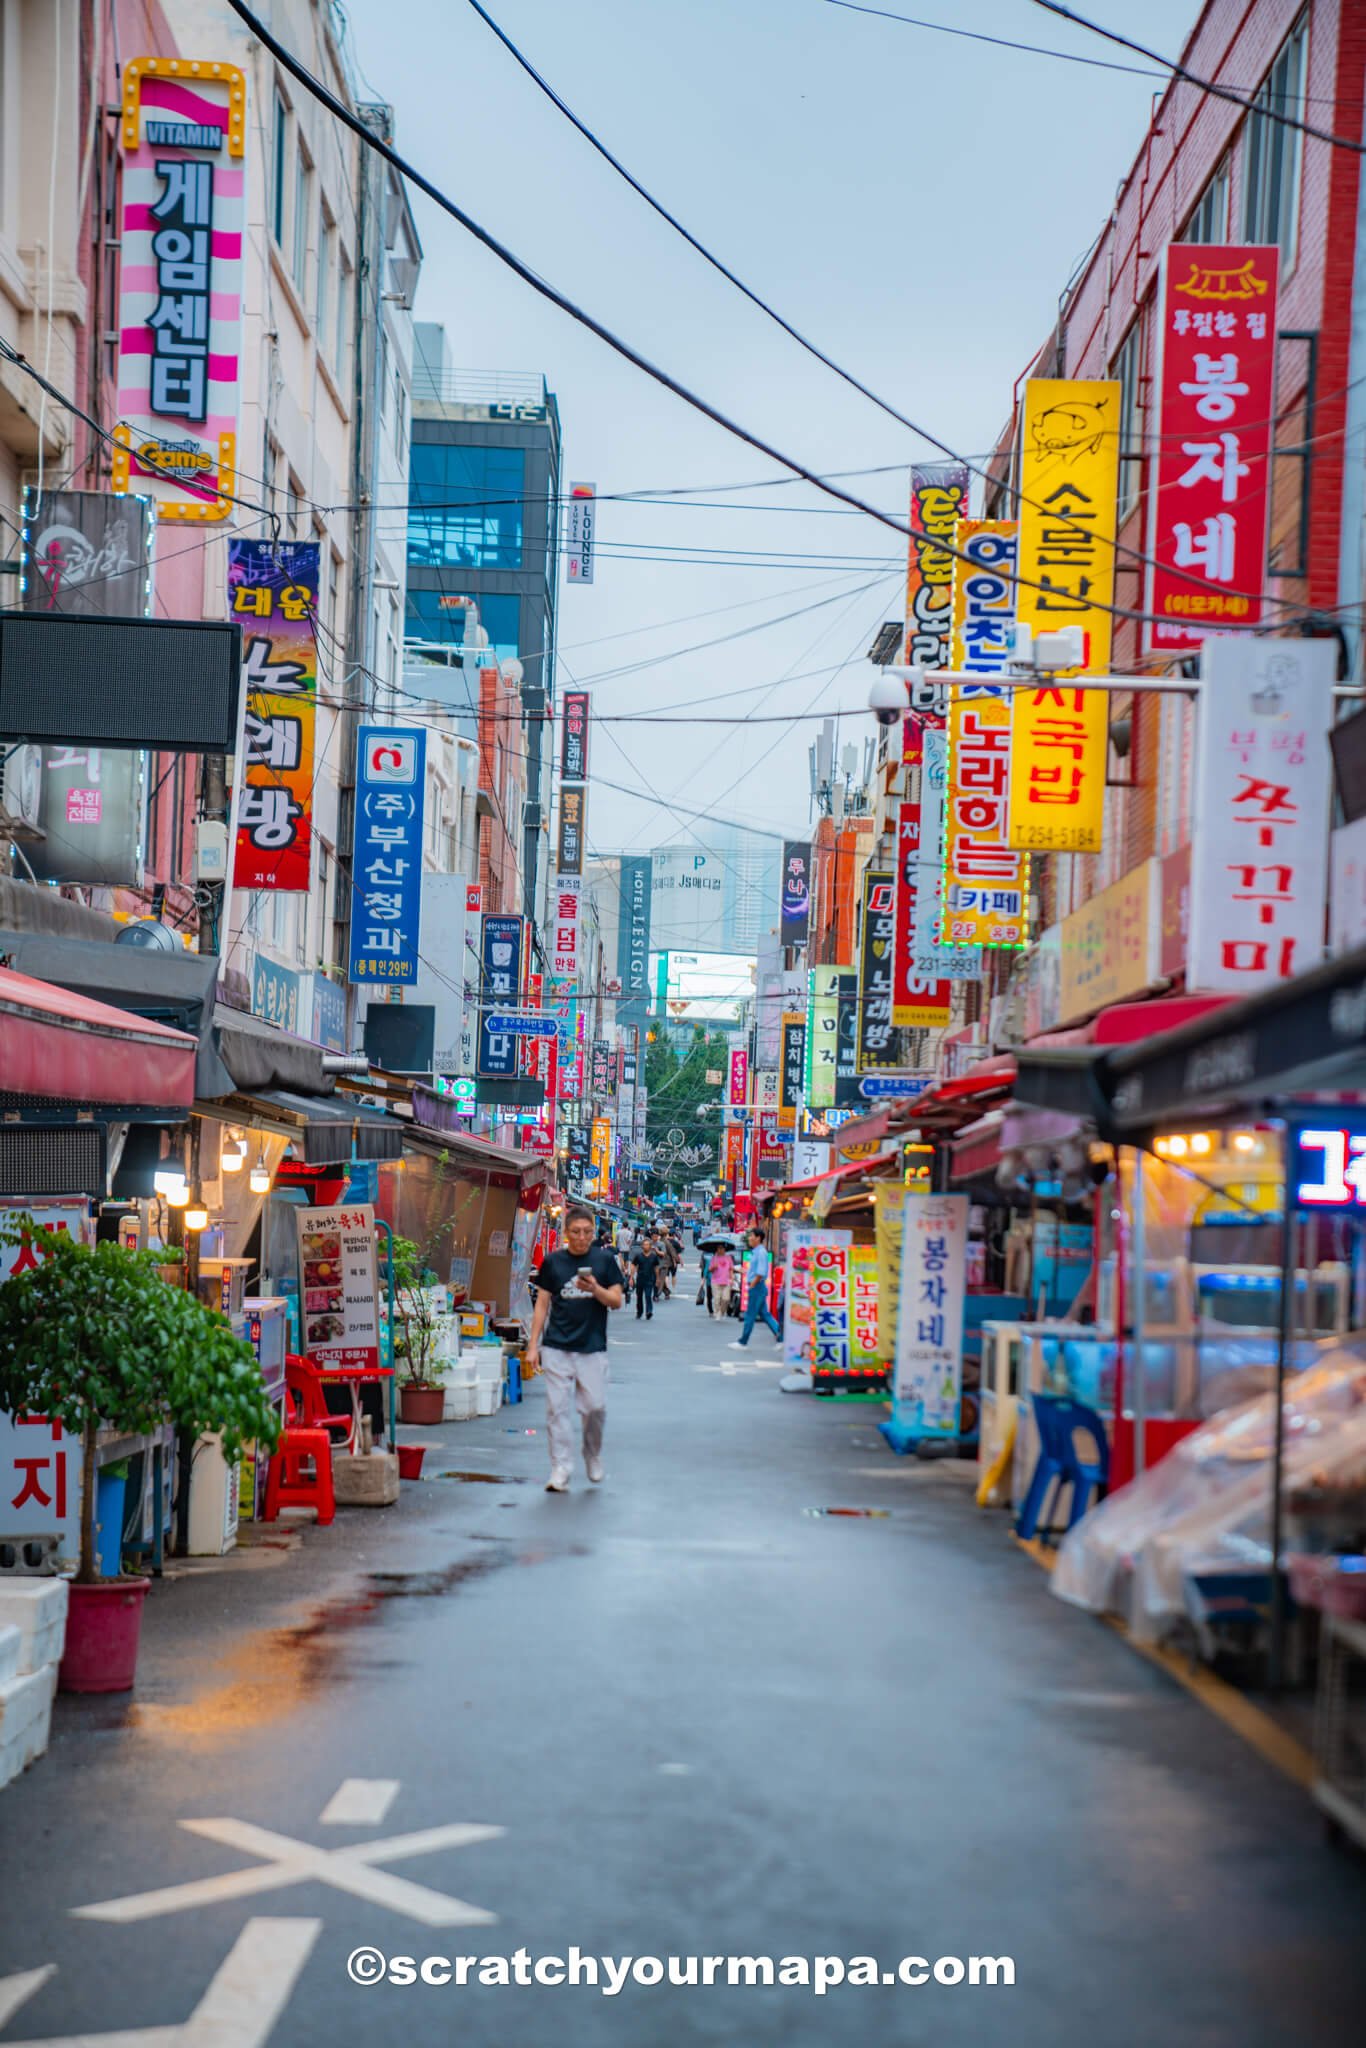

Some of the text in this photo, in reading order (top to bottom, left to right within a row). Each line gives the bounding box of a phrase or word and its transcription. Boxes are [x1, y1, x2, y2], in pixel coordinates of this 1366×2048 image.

[146, 122, 222, 149] VITAMIN
[147, 160, 213, 422] 게임센터
[1173, 310, 1266, 339] 푸짐한 집
[1173, 353, 1250, 582] 봉자네
[582, 505, 592, 577] LOUNGE
[1035, 483, 1097, 611] 소문난
[233, 585, 314, 622] 대운
[634, 868, 644, 911] HOTEL
[960, 890, 1018, 913] 카페
[953, 922, 974, 937] 2F
[555, 957, 576, 972] 만원
[815, 1250, 847, 1369] 여인천지
[917, 1236, 949, 1347] 봉자네
